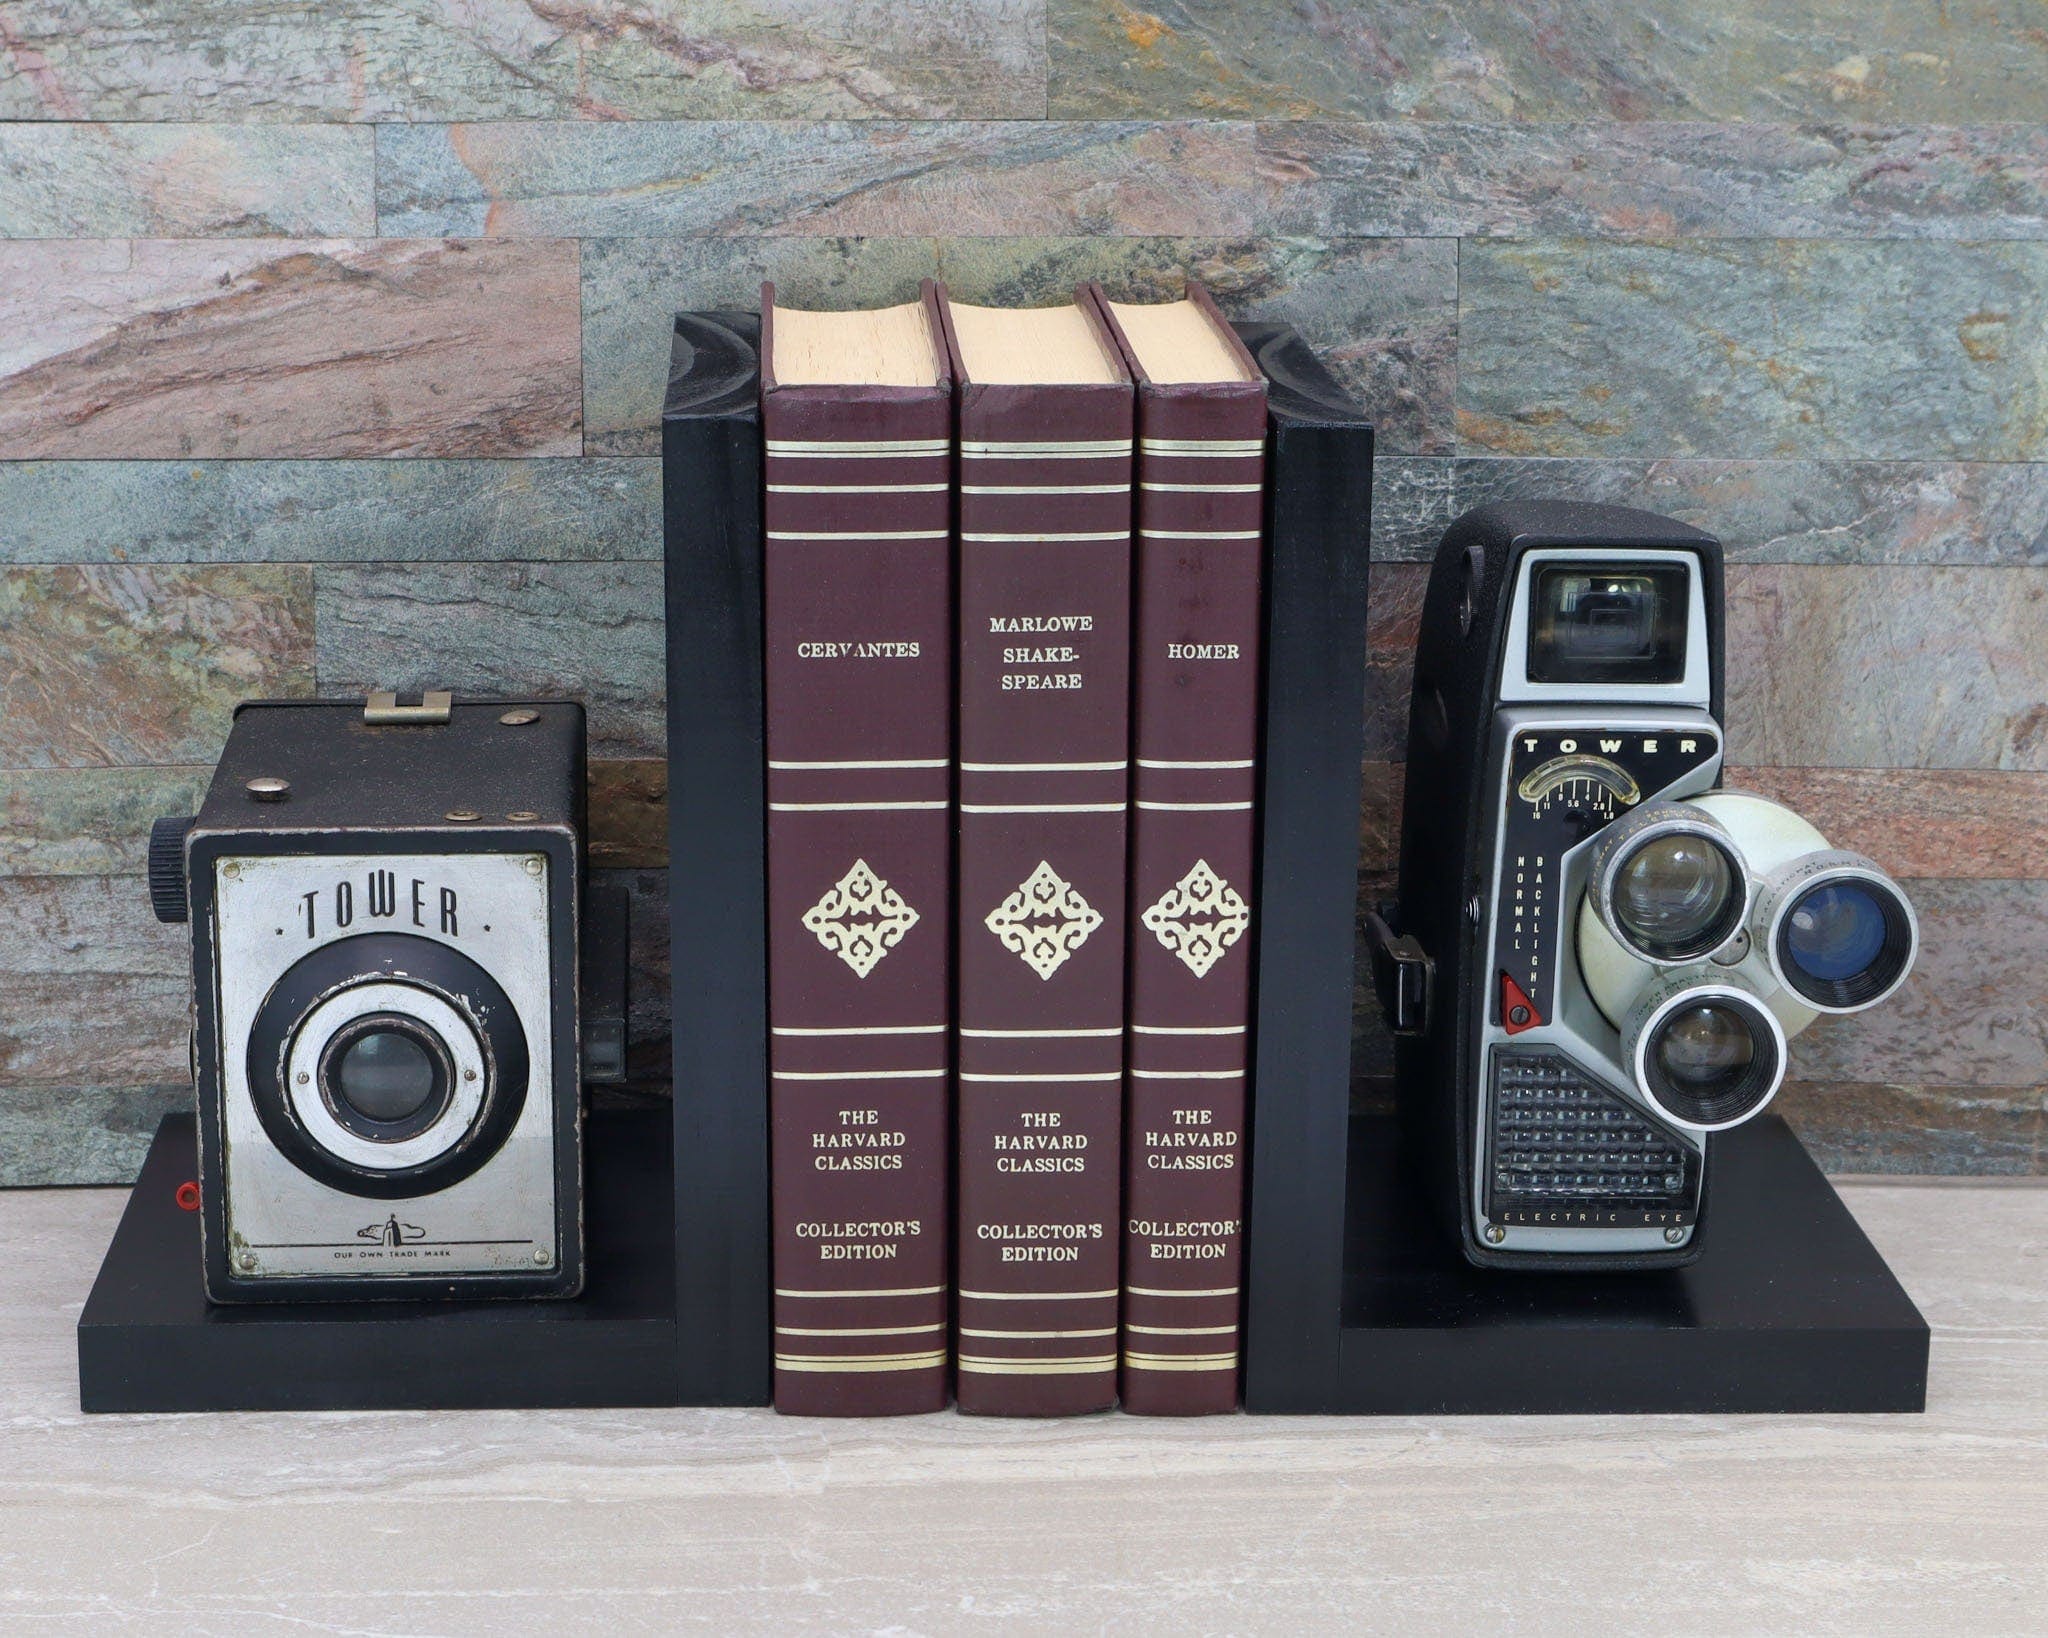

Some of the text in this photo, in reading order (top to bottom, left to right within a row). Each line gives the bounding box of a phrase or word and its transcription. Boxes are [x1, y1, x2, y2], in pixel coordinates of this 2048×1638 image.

[989, 615, 1093, 633] MARLOWE
[797, 642, 920, 658] CERVANTES
[1003, 646, 1080, 664] SHAKE-
[1167, 643, 1240, 660] HOMER
[1001, 673, 1082, 690] SPEARE
[1523, 738, 1697, 757] TOWER
[1584, 793, 1590, 801] 4
[303, 869, 458, 939] TOWER
[1514, 856, 1525, 950] NORMAL
[1530, 856, 1544, 999] BACKLIGHT
[838, 1110, 879, 1125] THE
[1020, 1112, 1061, 1128] THE
[1172, 1109, 1212, 1125] THE
[812, 1132, 906, 1148] HARVARD
[994, 1134, 1088, 1150] HARVARD
[1145, 1131, 1237, 1147] HARVARD
[814, 1154, 903, 1171] CLASSICS
[996, 1157, 1085, 1173] CLASSICS
[1147, 1153, 1234, 1170] CLASSICS
[1504, 1212, 1682, 1222] ELECTRIC EYE
[795, 1220, 921, 1238] COLLECTOR'S
[976, 1223, 1103, 1240] COLLECTOR'S
[1129, 1219, 1241, 1237] COLLECTOR'
[820, 1243, 897, 1260] EDITION
[1001, 1246, 1079, 1262] EDITION
[1150, 1243, 1226, 1259] EDITION
